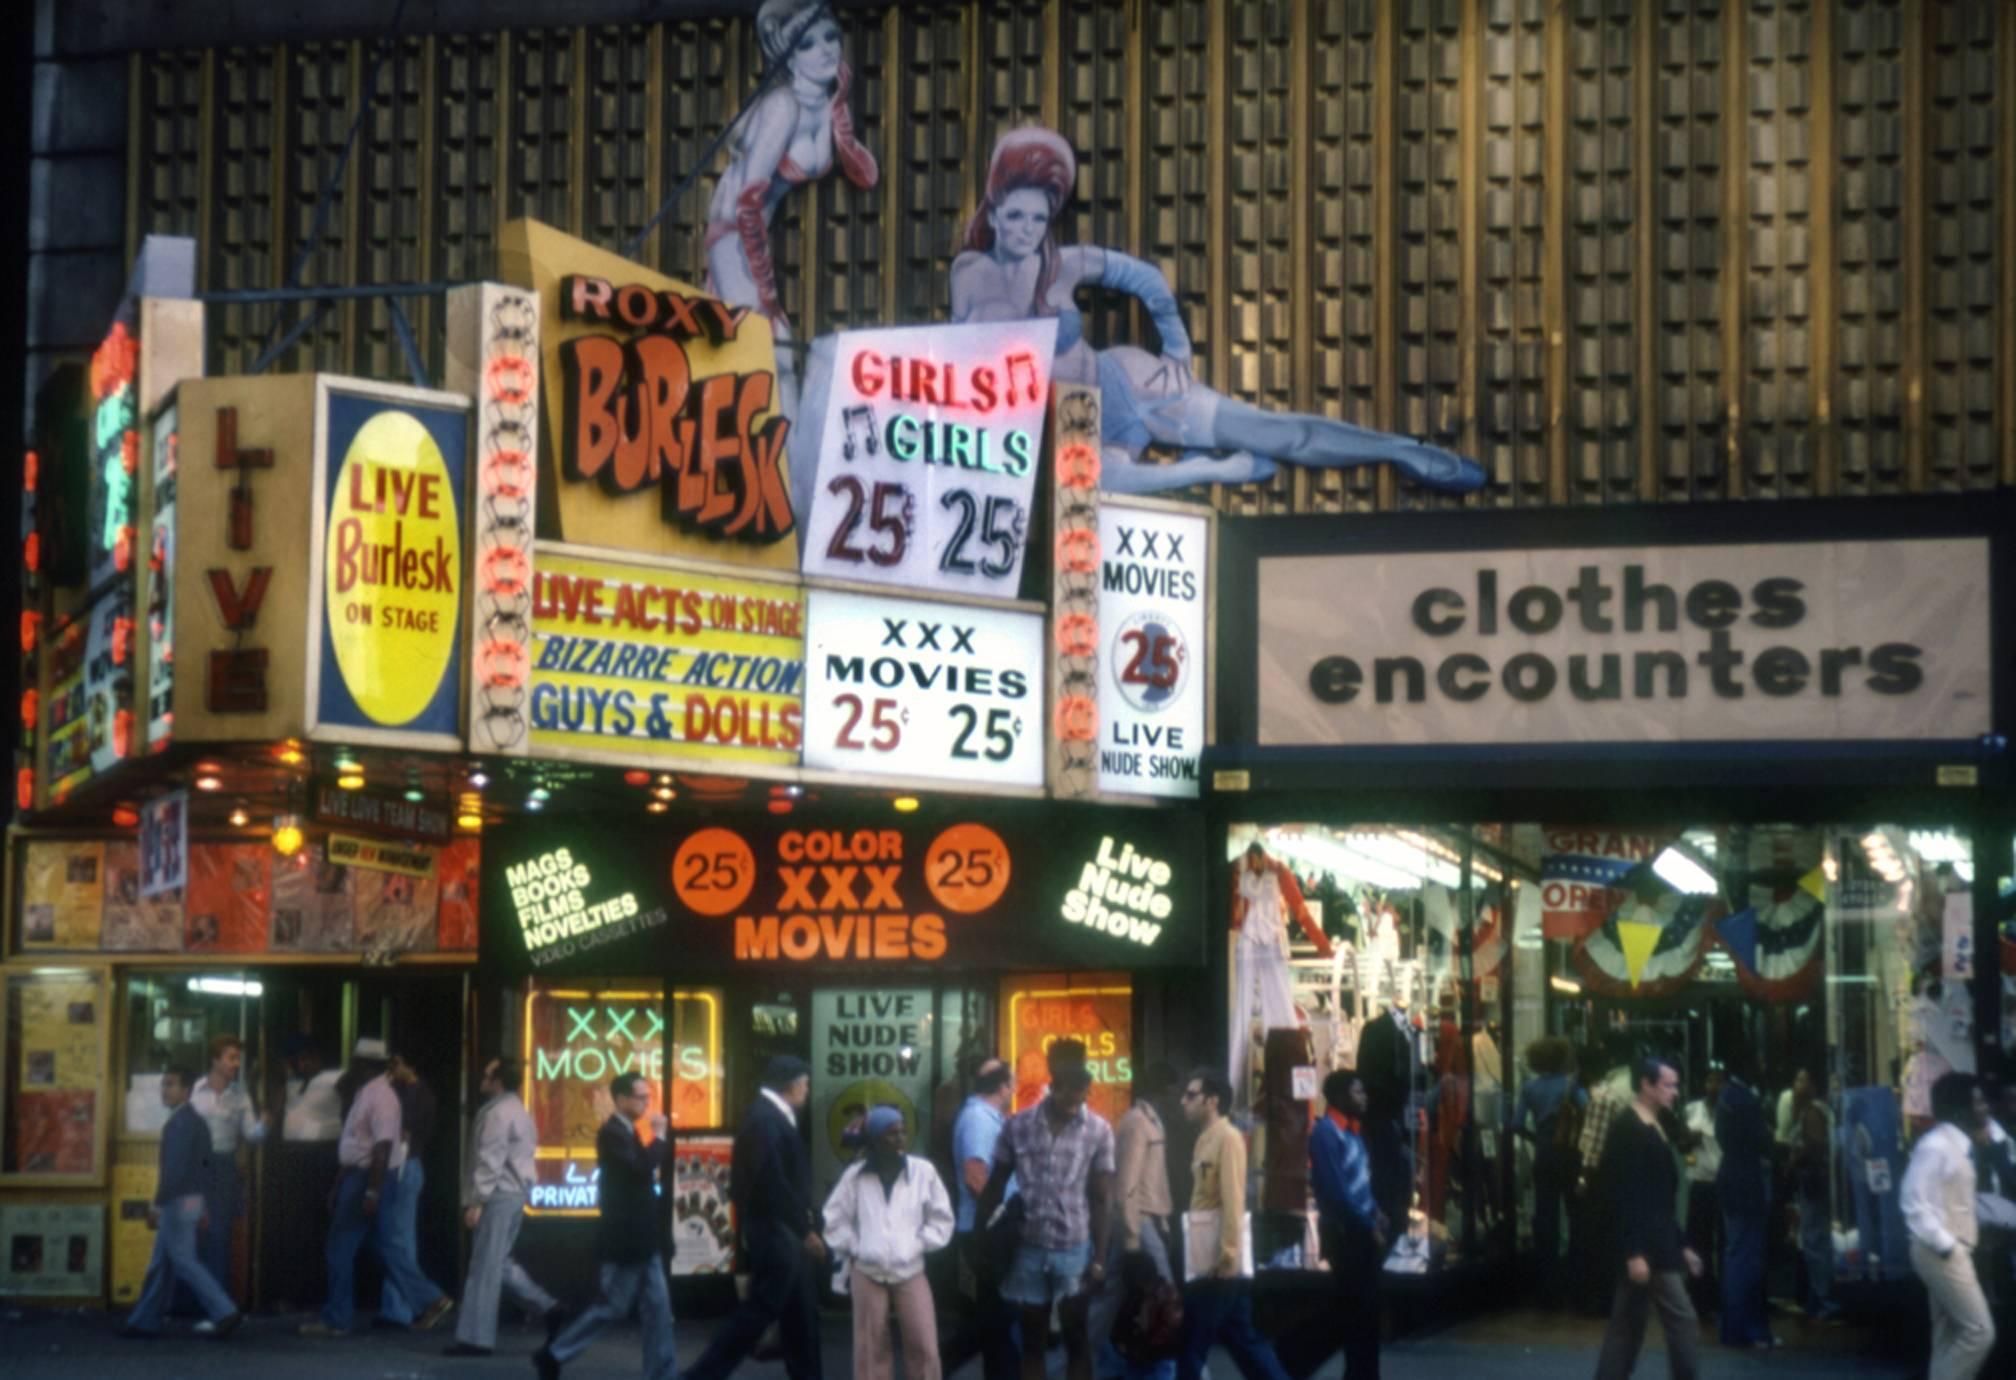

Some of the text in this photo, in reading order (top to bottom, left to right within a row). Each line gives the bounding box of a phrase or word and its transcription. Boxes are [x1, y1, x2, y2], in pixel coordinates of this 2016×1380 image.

[561, 274, 748, 346] ROXY
[852, 350, 998, 413] GIRLS
[560, 334, 793, 545] BURLESK
[885, 414, 1031, 477] GIRLS
[350, 463, 440, 520] LIVE
[205, 406, 276, 713] LIVE
[336, 517, 454, 593] Burlesk
[532, 571, 802, 638] LIVE ACTS ON STAGE
[1103, 561, 1196, 601] MOVIES
[1412, 564, 1807, 637] clothes
[346, 603, 438, 633] ON STAGE
[537, 635, 803, 695] BIZARRE ACTION
[825, 653, 1028, 700] MOVIES
[1307, 630, 1924, 704] encounters
[531, 682, 803, 750] GUYS & DOLLS
[1113, 721, 1184, 750] LIVE
[1101, 750, 1143, 777] NUDE
[1149, 754, 1199, 781] SHOW
[505, 847, 574, 889] MAGS
[778, 829, 904, 862] COLOR
[1096, 835, 1172, 887] Live
[1550, 831, 1655, 859] GRAN
[511, 863, 592, 909] BOOKS
[517, 889, 586, 930] FILMS
[776, 866, 904, 911] XXX
[1077, 861, 1173, 918] Nude
[523, 891, 640, 951] NOVELTIES
[578, 906, 668, 950] CASSETTES
[734, 913, 948, 961] MOVIES
[1060, 888, 1163, 947] Show
[837, 994, 915, 1020] LIVE
[827, 1025, 918, 1048] NUDE
[826, 1052, 923, 1077] SHOW
[530, 1185, 599, 1207] PRIVAT
